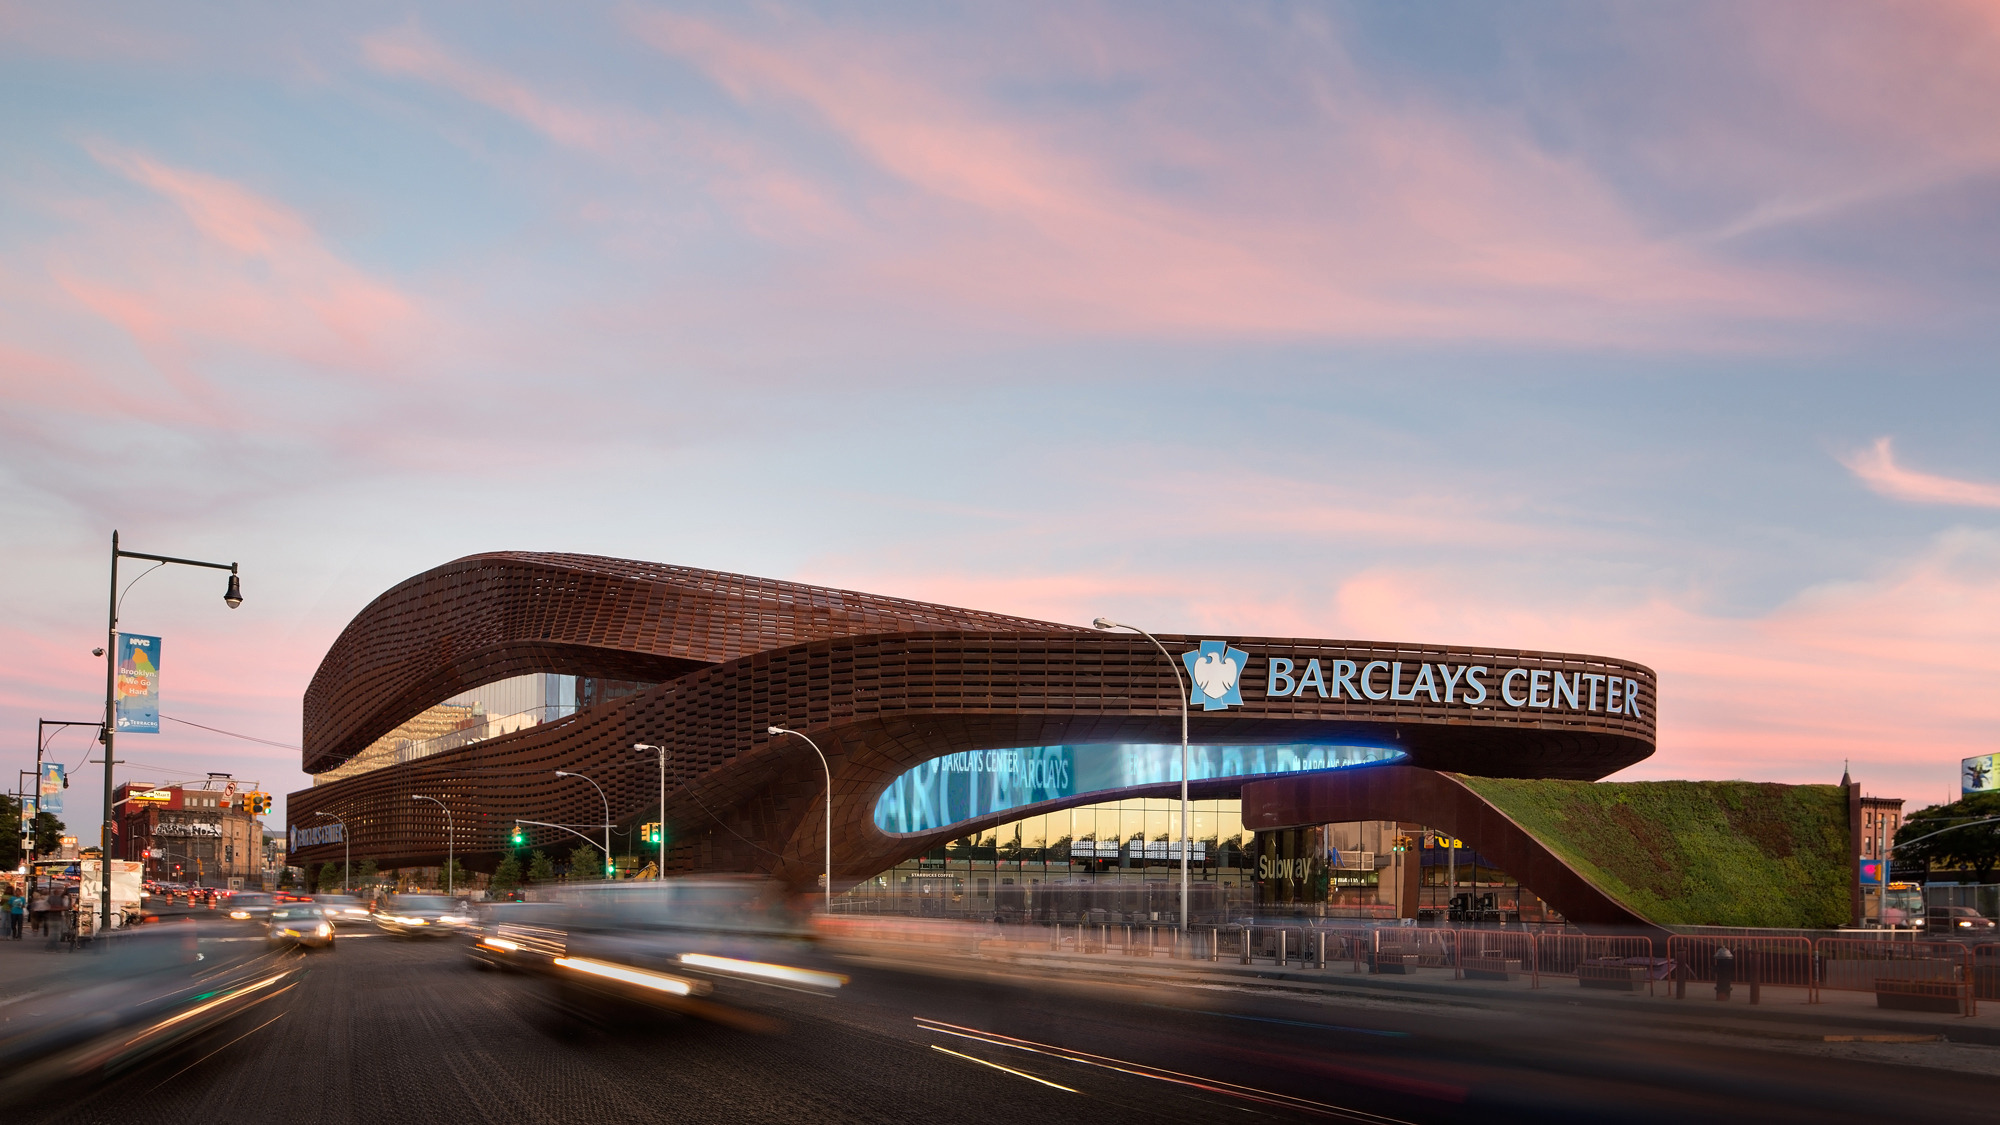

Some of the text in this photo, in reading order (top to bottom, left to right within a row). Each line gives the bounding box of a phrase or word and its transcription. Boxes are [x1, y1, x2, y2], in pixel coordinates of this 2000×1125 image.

[121, 668, 157, 677] Brooklyn.
[1266, 657, 1642, 718] BARCLAYS CENTER
[941, 750, 1018, 773] BARCLAYS CENTER
[1013, 759, 1068, 788] BARCLAYS
[1260, 854, 1313, 884] Subway
